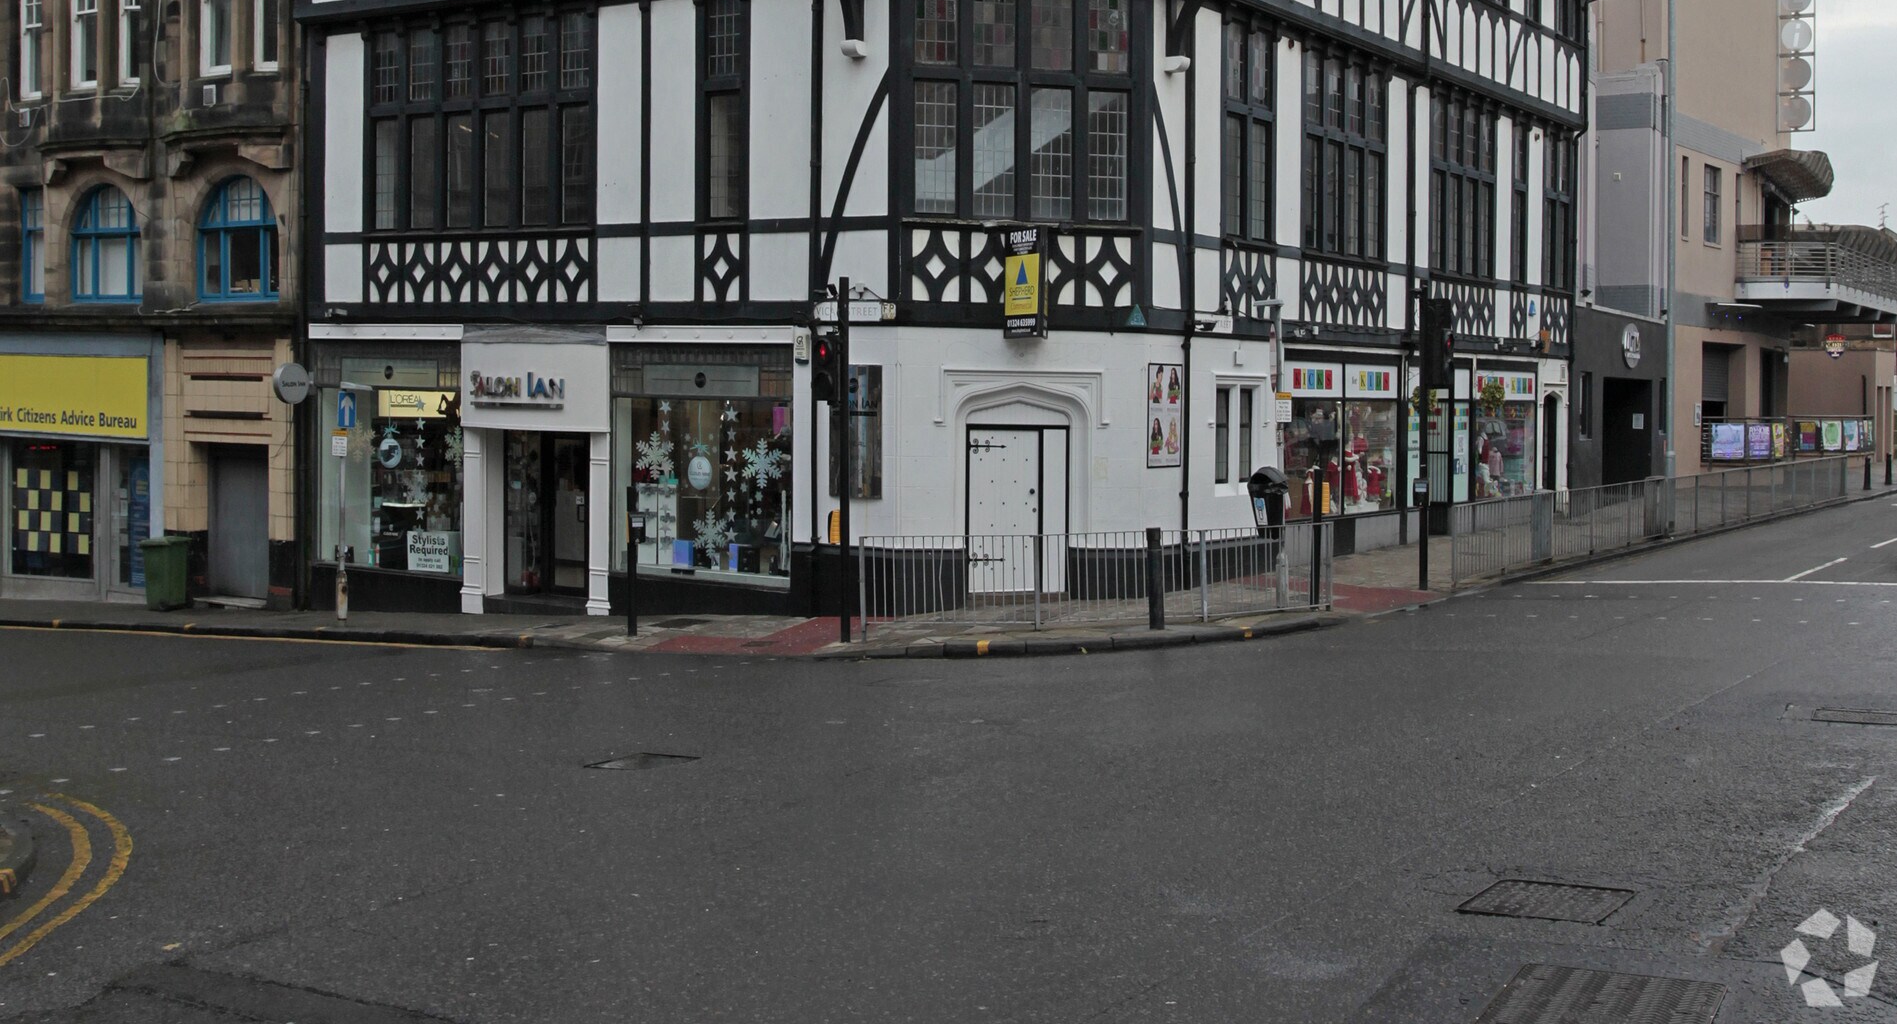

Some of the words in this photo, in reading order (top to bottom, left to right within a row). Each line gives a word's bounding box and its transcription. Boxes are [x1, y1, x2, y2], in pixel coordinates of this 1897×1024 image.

[1010, 231, 1022, 244] FOR
[1022, 229, 1037, 242] SALE
[1009, 286, 1035, 296] SHEPHERD
[816, 306, 838, 317] VICA
[848, 306, 878, 316] TREET
[1294, 369, 1333, 389] KICKS
[1360, 371, 1390, 391] KIDS
[17, 407, 56, 424] Citizens
[61, 410, 95, 426] Advice
[99, 412, 137, 428] Bureau
[412, 535, 445, 546] Stylists
[409, 544, 448, 556] Required
